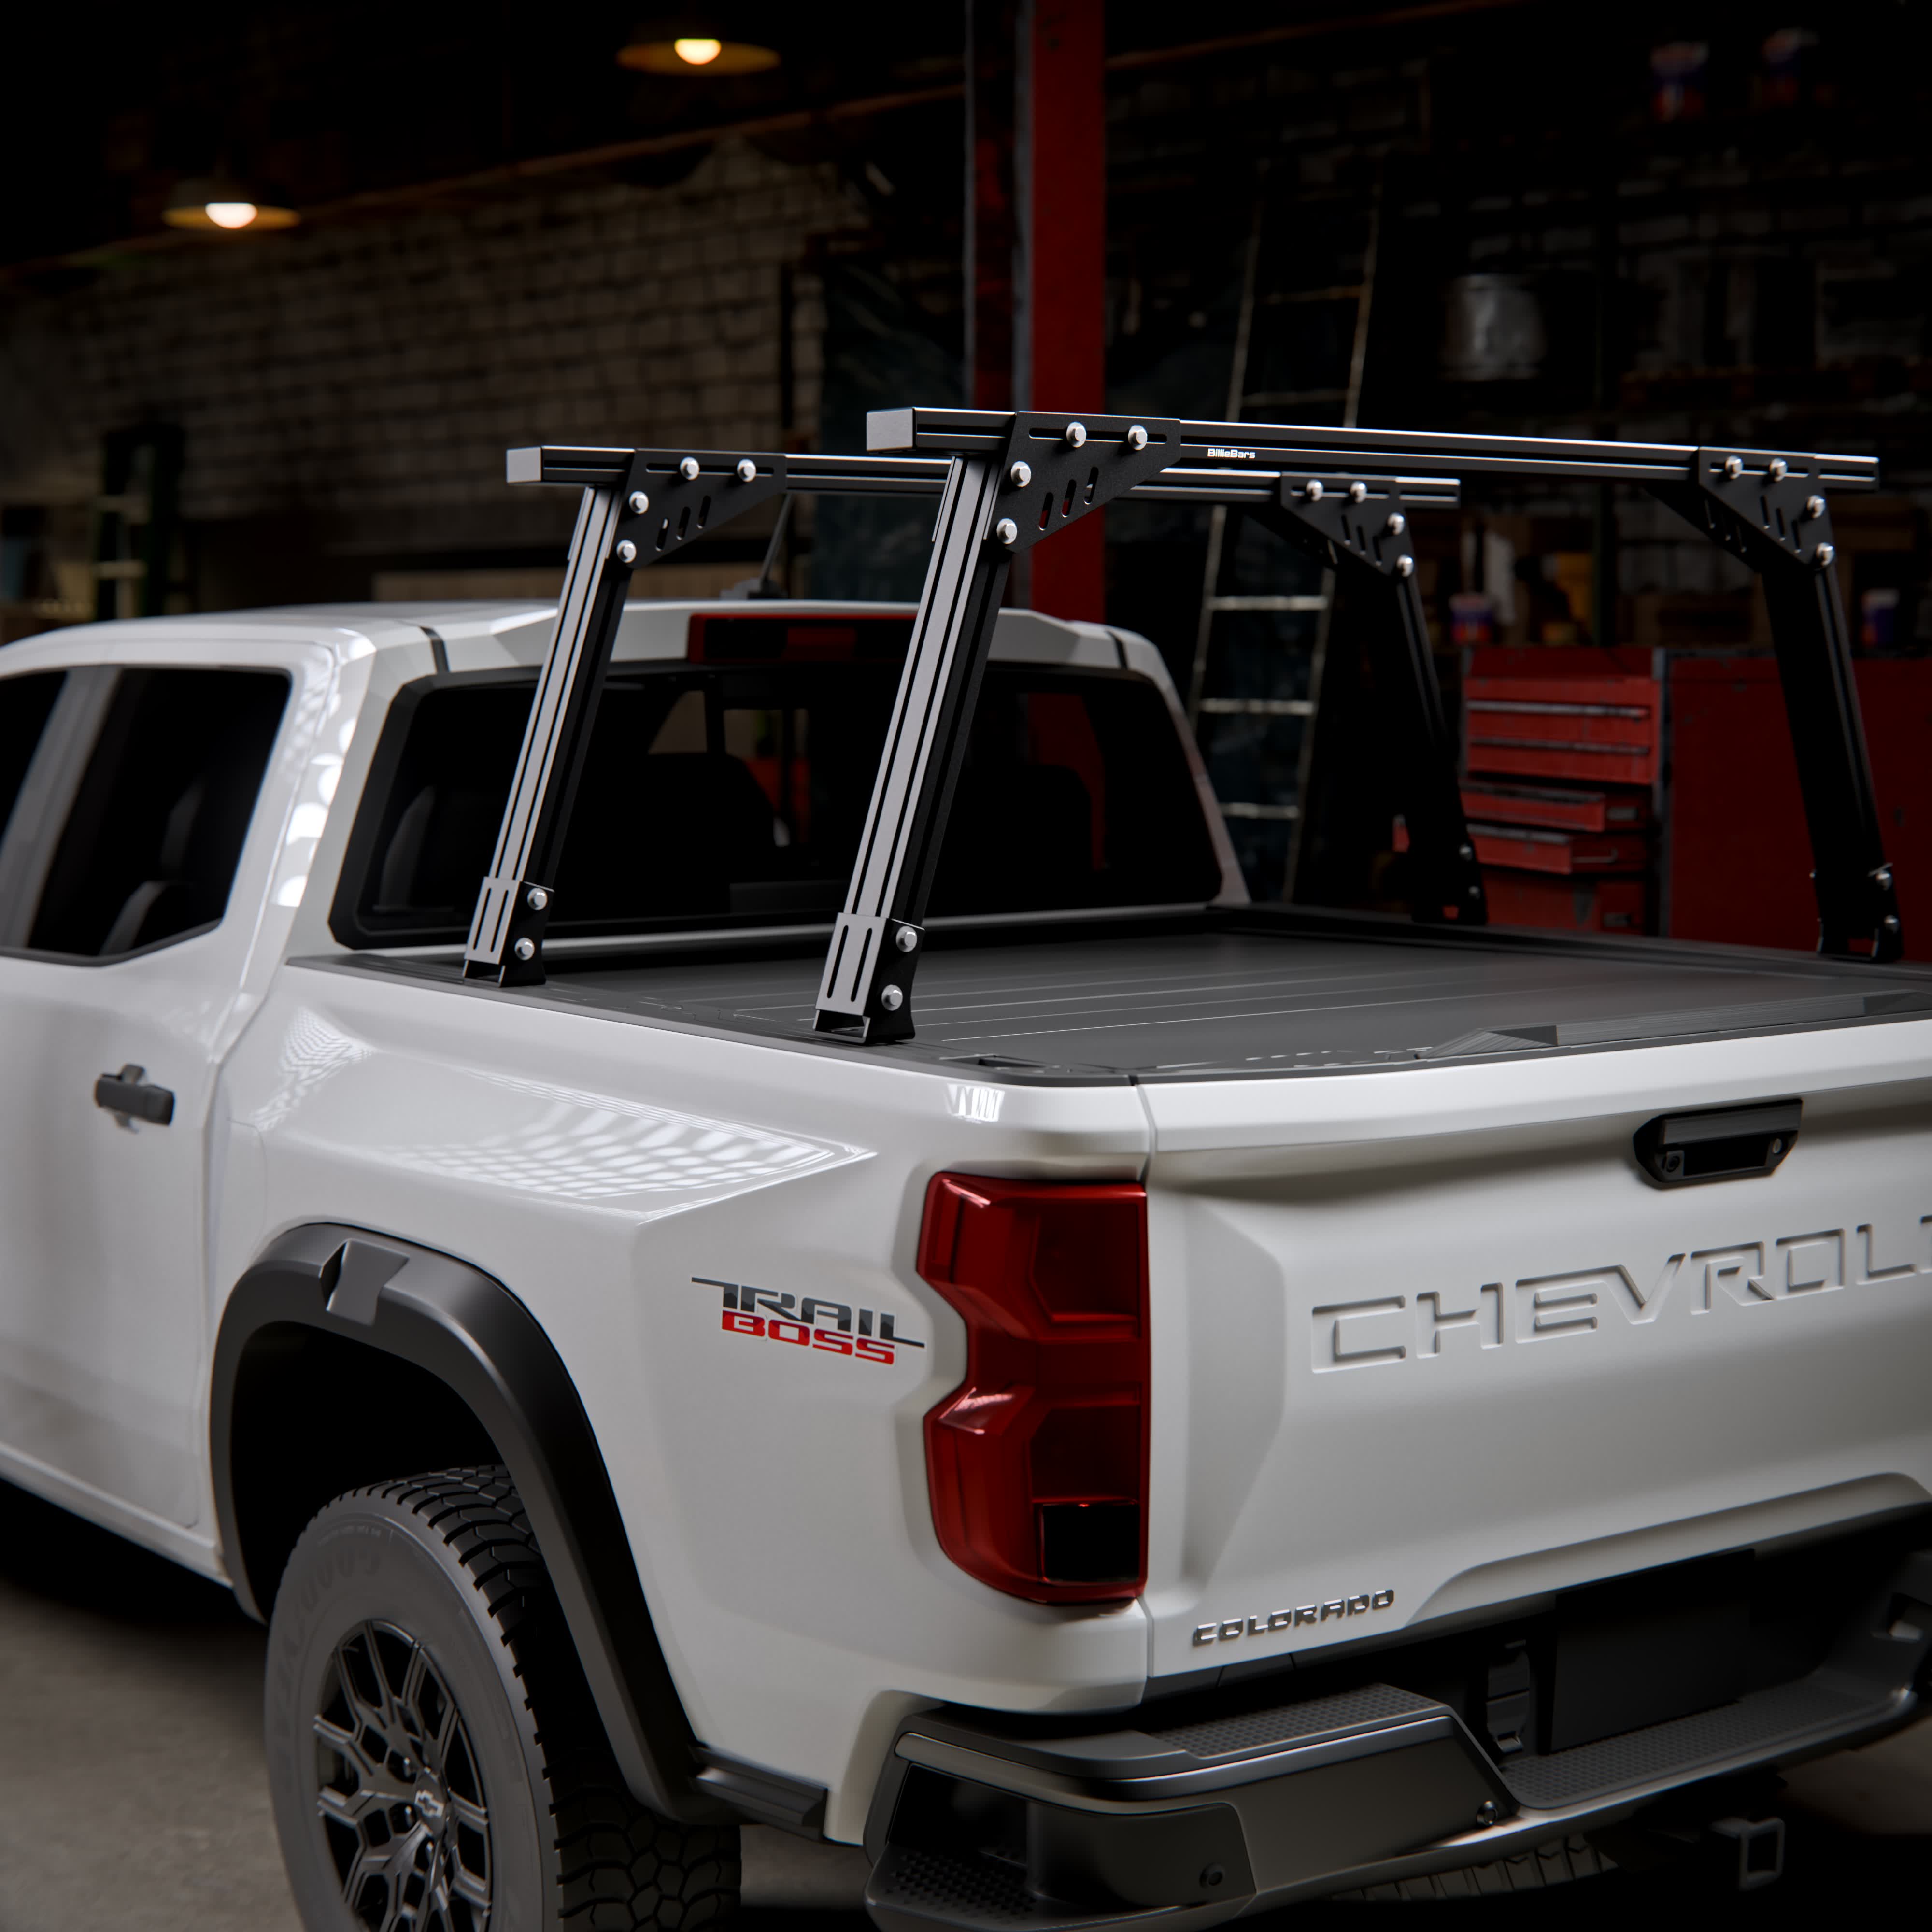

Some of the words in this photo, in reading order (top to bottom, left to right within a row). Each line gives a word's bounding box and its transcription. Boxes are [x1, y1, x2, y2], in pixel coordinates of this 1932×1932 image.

[1208, 448, 1256, 459] BillieBars
[692, 1277, 924, 1348] TRAIL
[1311, 1214, 1932, 1374] CHEVROL
[722, 1310, 895, 1364] BOSS
[1193, 1589, 1394, 1647] COLORADO
